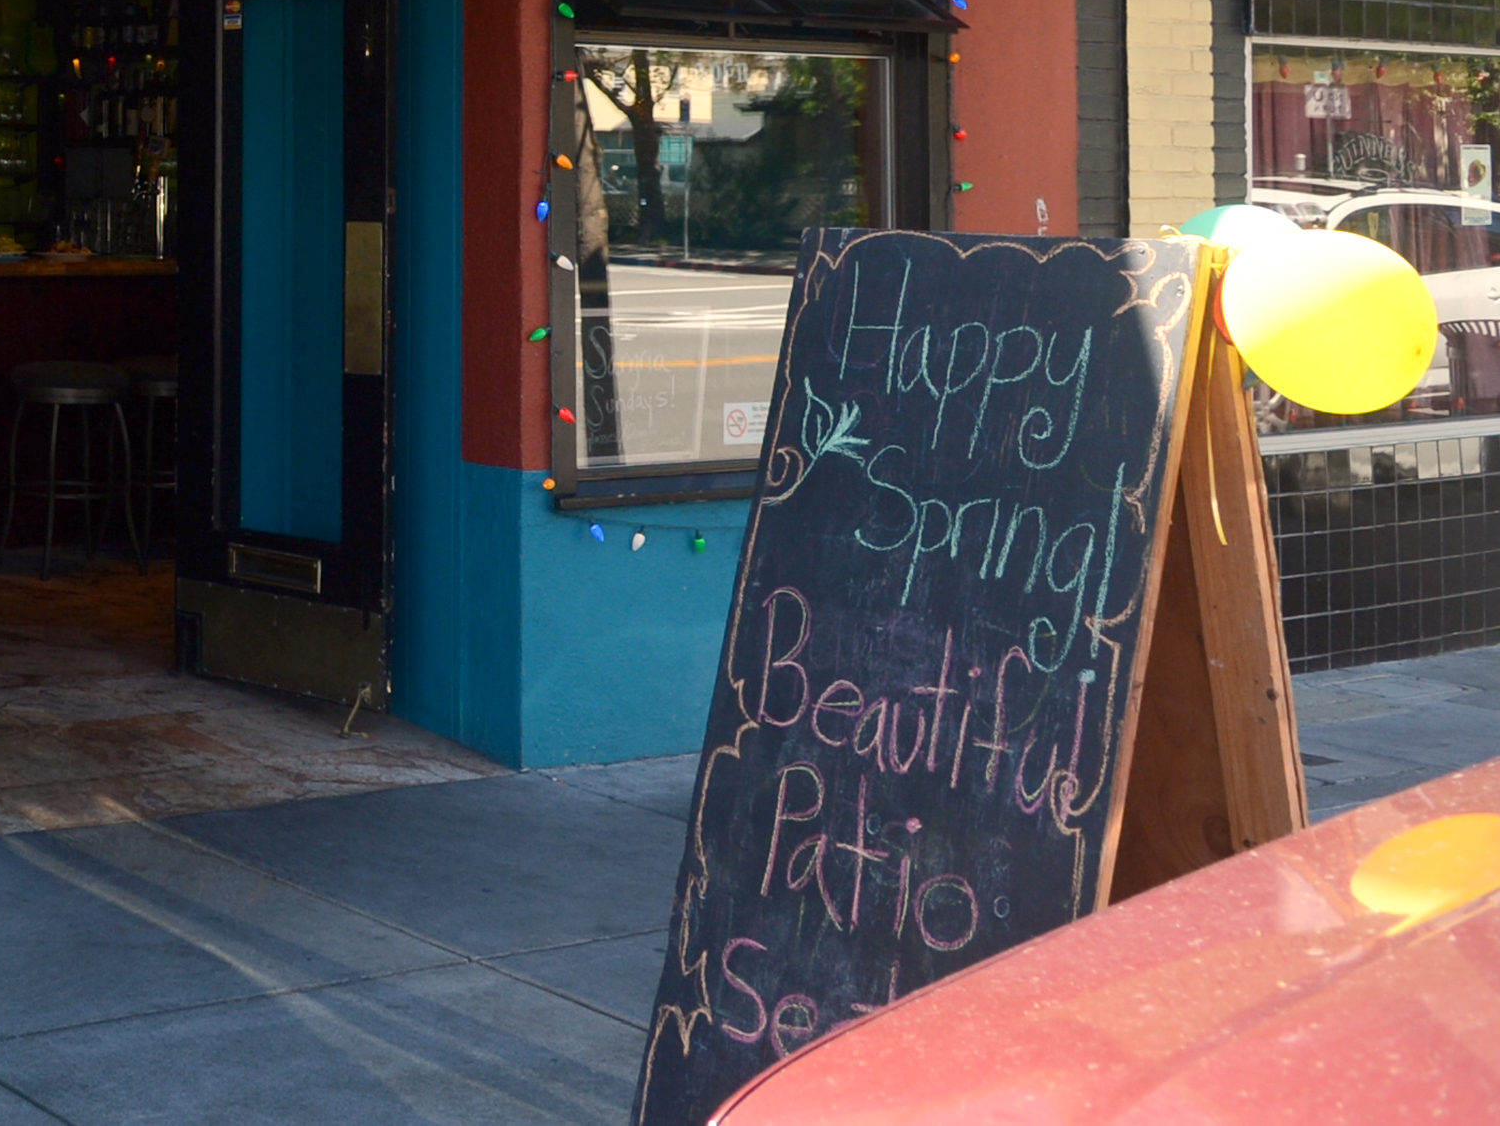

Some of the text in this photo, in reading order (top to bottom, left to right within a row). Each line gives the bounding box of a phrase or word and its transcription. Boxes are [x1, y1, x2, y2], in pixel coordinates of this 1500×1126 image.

[840, 259, 1094, 470] Happy
[853, 445, 1127, 684] Spring!
[755, 587, 1090, 823] Beautiful
[760, 761, 979, 952] Patio
